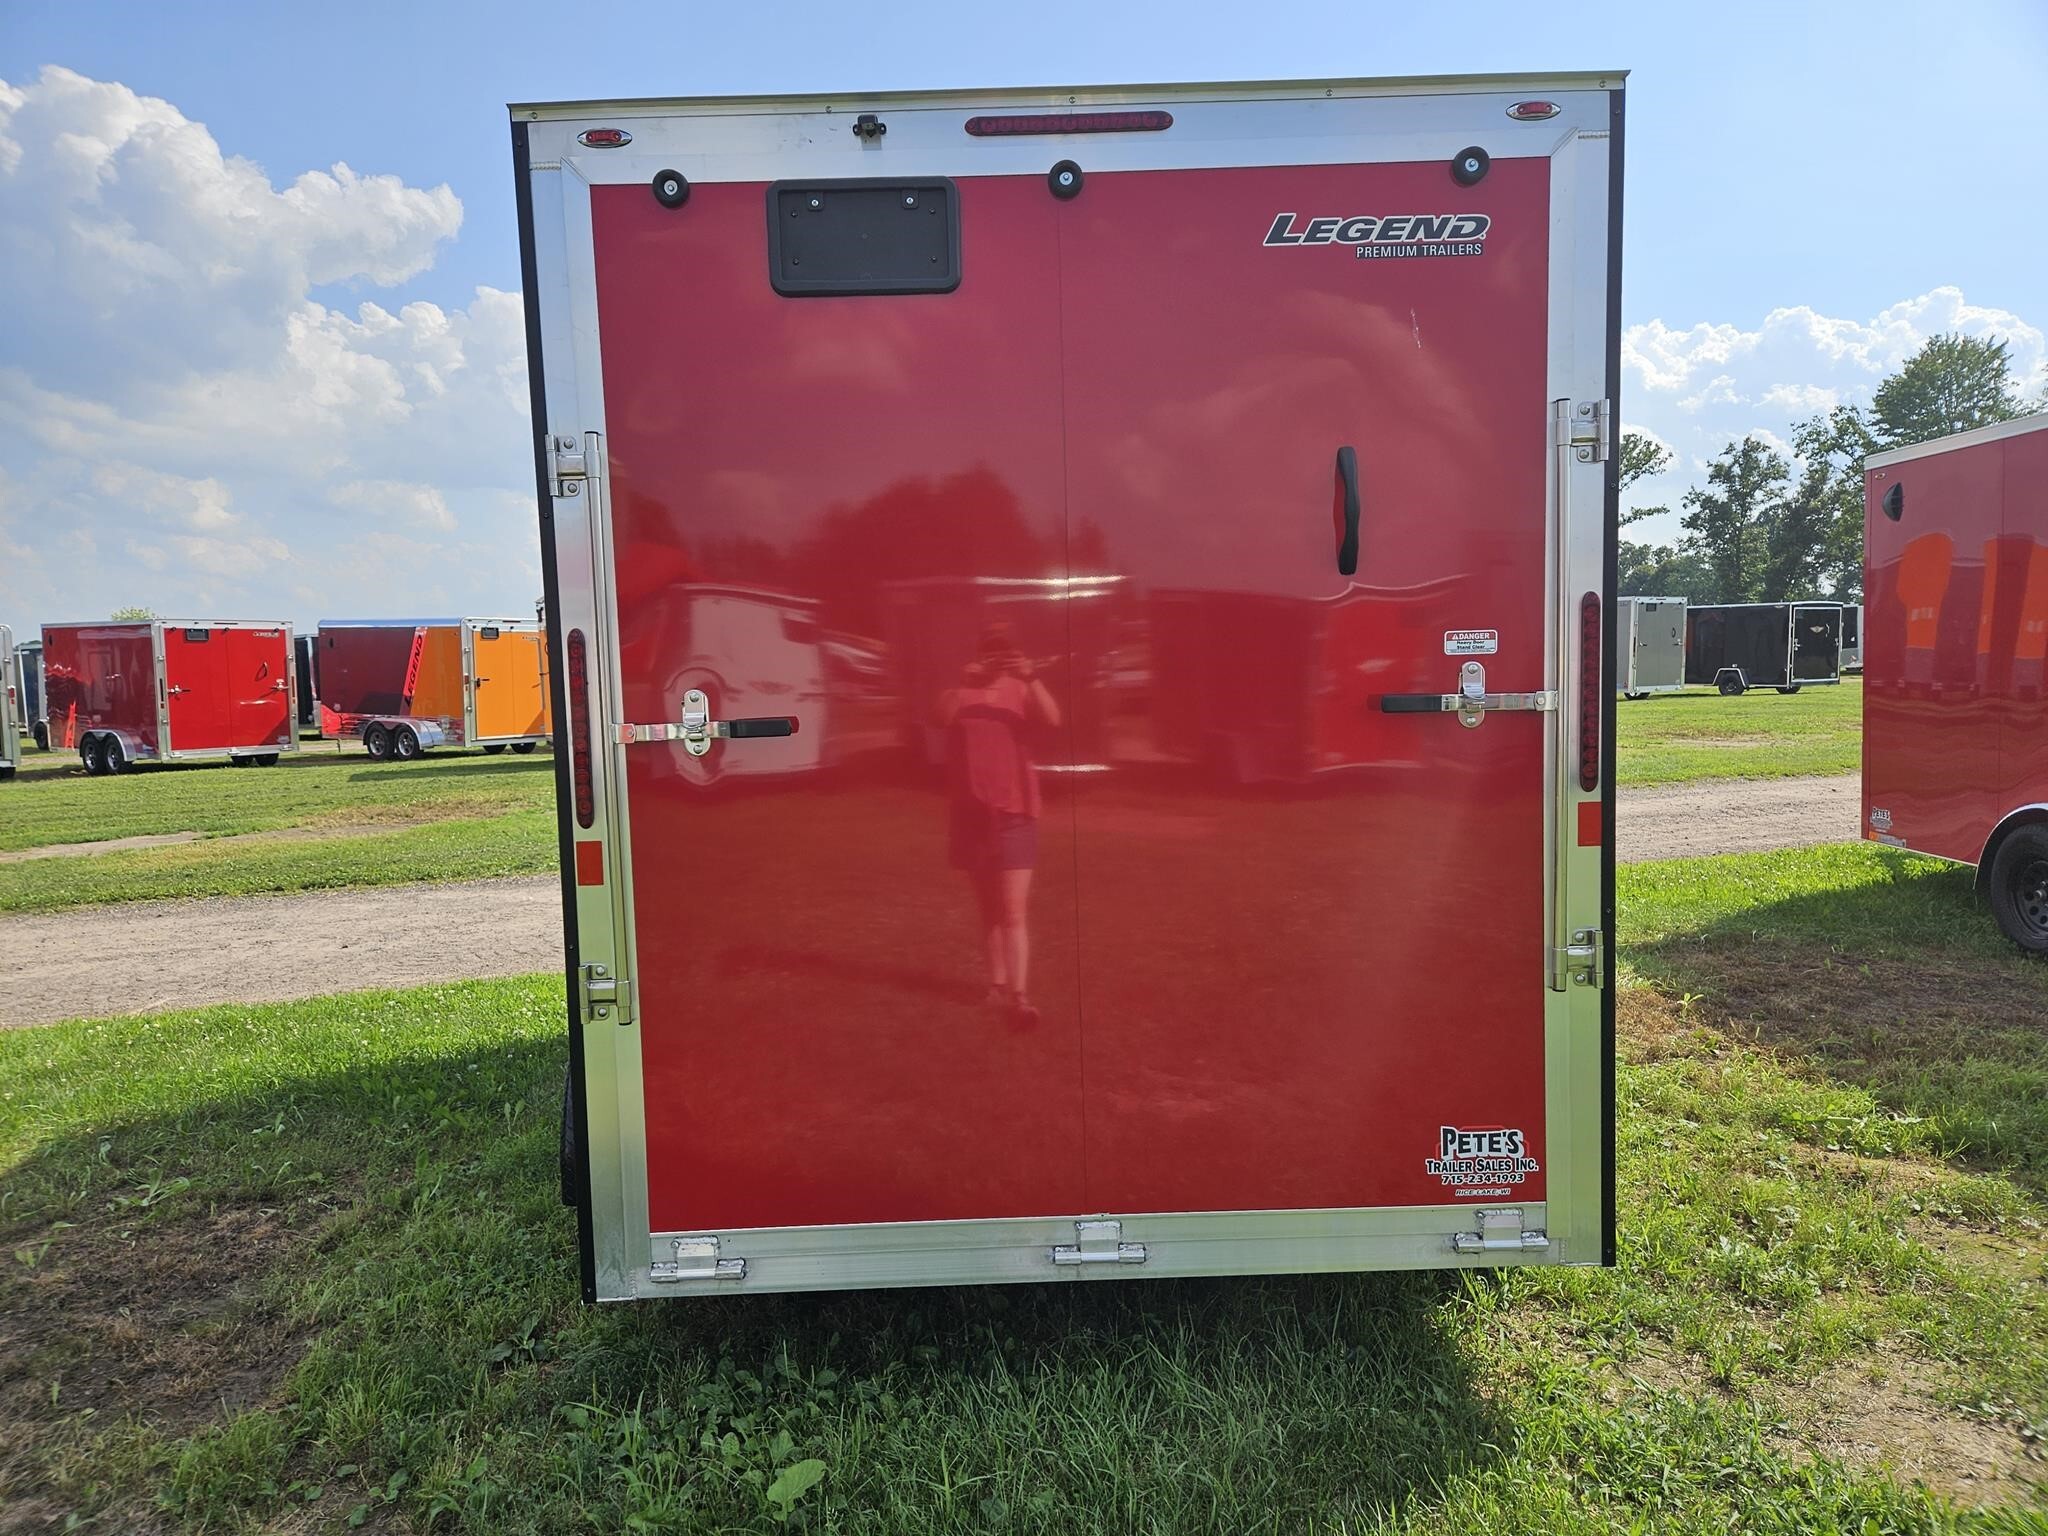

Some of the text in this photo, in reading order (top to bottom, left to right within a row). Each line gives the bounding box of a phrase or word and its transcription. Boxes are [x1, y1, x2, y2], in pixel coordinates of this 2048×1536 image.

[1263, 212, 1491, 246] LEGEND
[1356, 244, 1482, 258] PREMIUM TRAILERS
[1441, 1126, 1524, 1158] PETE'S
[1426, 1157, 1539, 1174] TRAILER SALES INC.
[1442, 1173, 1524, 1184] 715-234-1993
